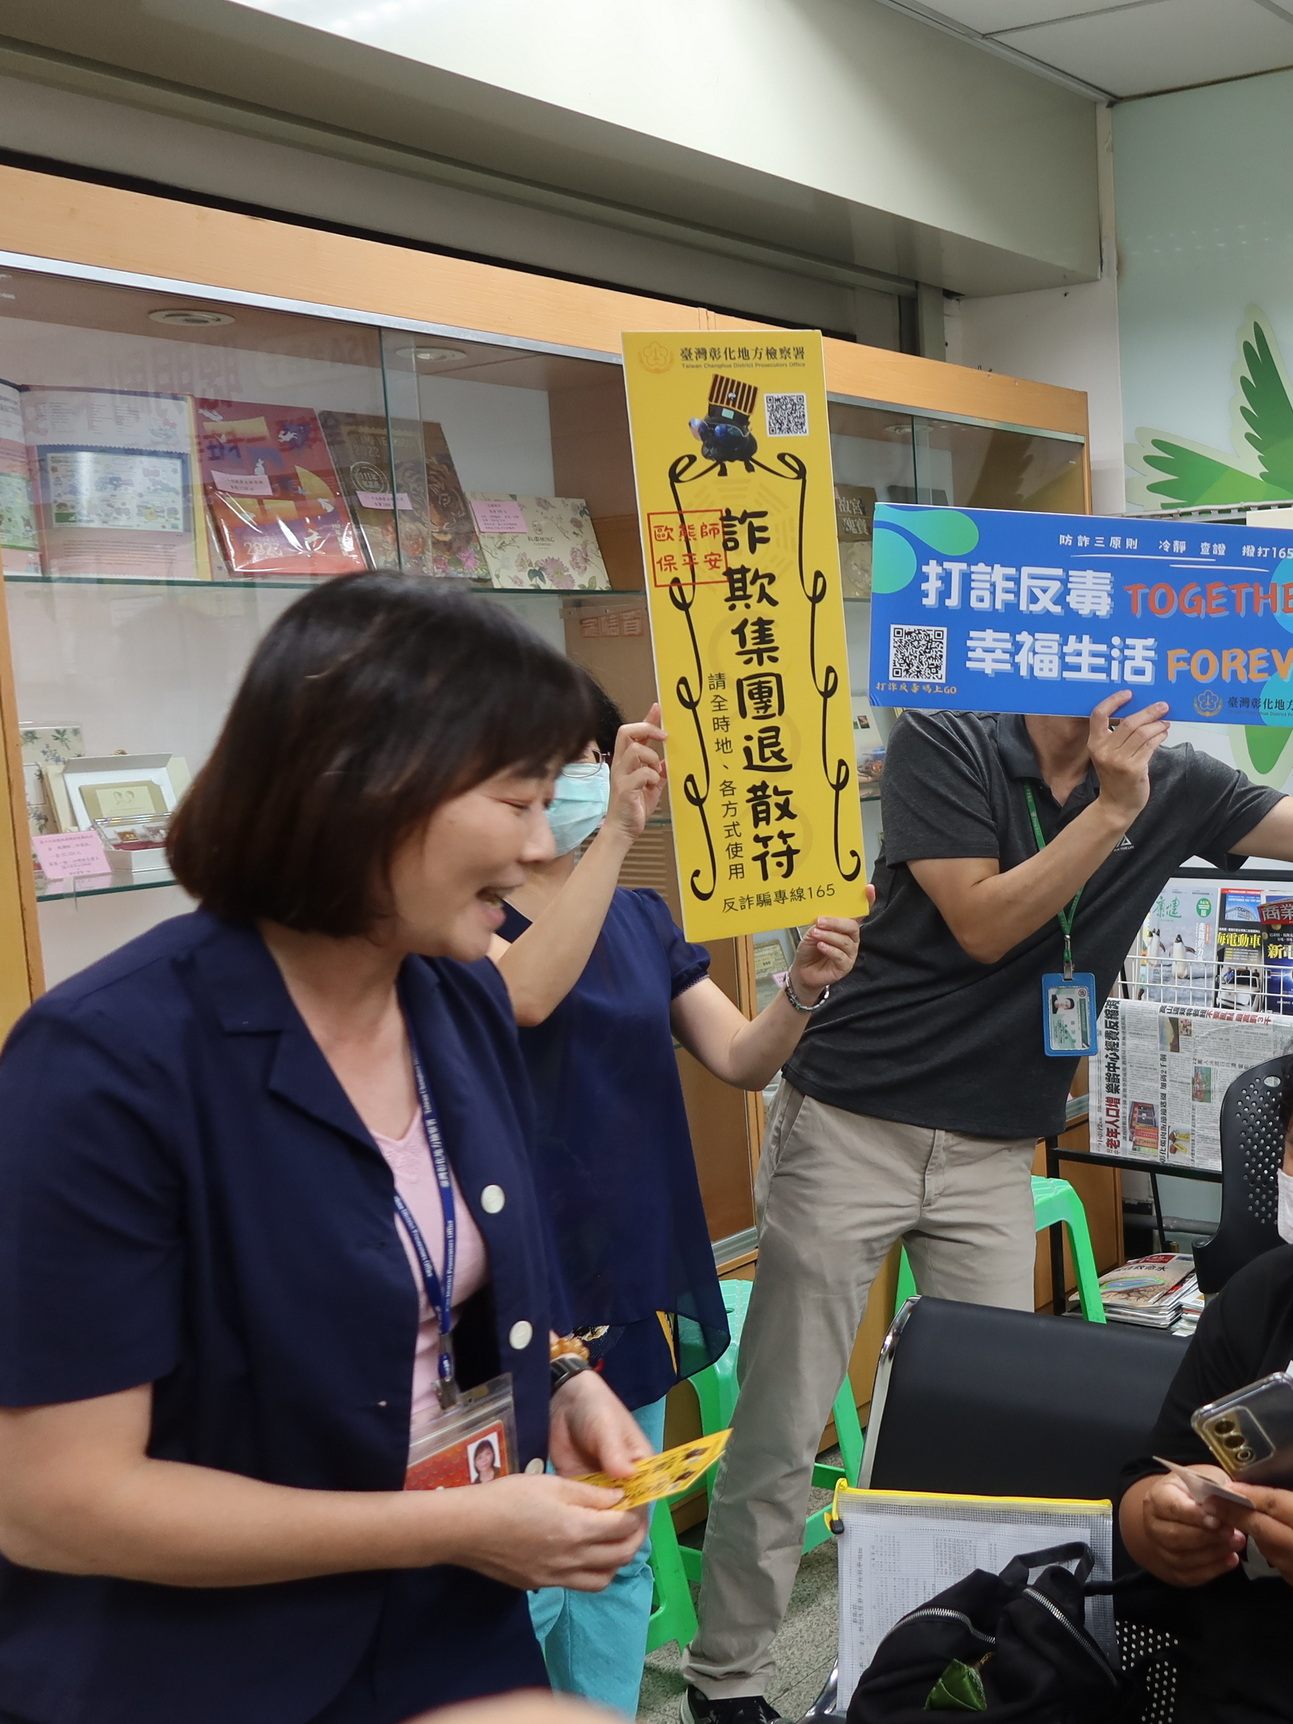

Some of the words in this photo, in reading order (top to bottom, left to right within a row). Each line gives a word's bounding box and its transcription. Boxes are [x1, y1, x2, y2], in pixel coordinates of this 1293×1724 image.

[680, 345, 806, 362] 臺灣彰化地方檢察署
[653, 522, 721, 543] 歐熊師
[1058, 534, 1139, 550] 防詐三原則
[1158, 539, 1187, 554] 冷靜
[1200, 542, 1227, 556] 查證
[656, 552, 723, 573] 保平安
[920, 559, 1115, 617] 打詐反毒
[965, 629, 1157, 684] 幸福生活
[722, 507, 801, 881] 詐欺集團退散符
[708, 671, 746, 881] 請全時地、各方式使用
[721, 883, 837, 915] 反詐騙專線165
